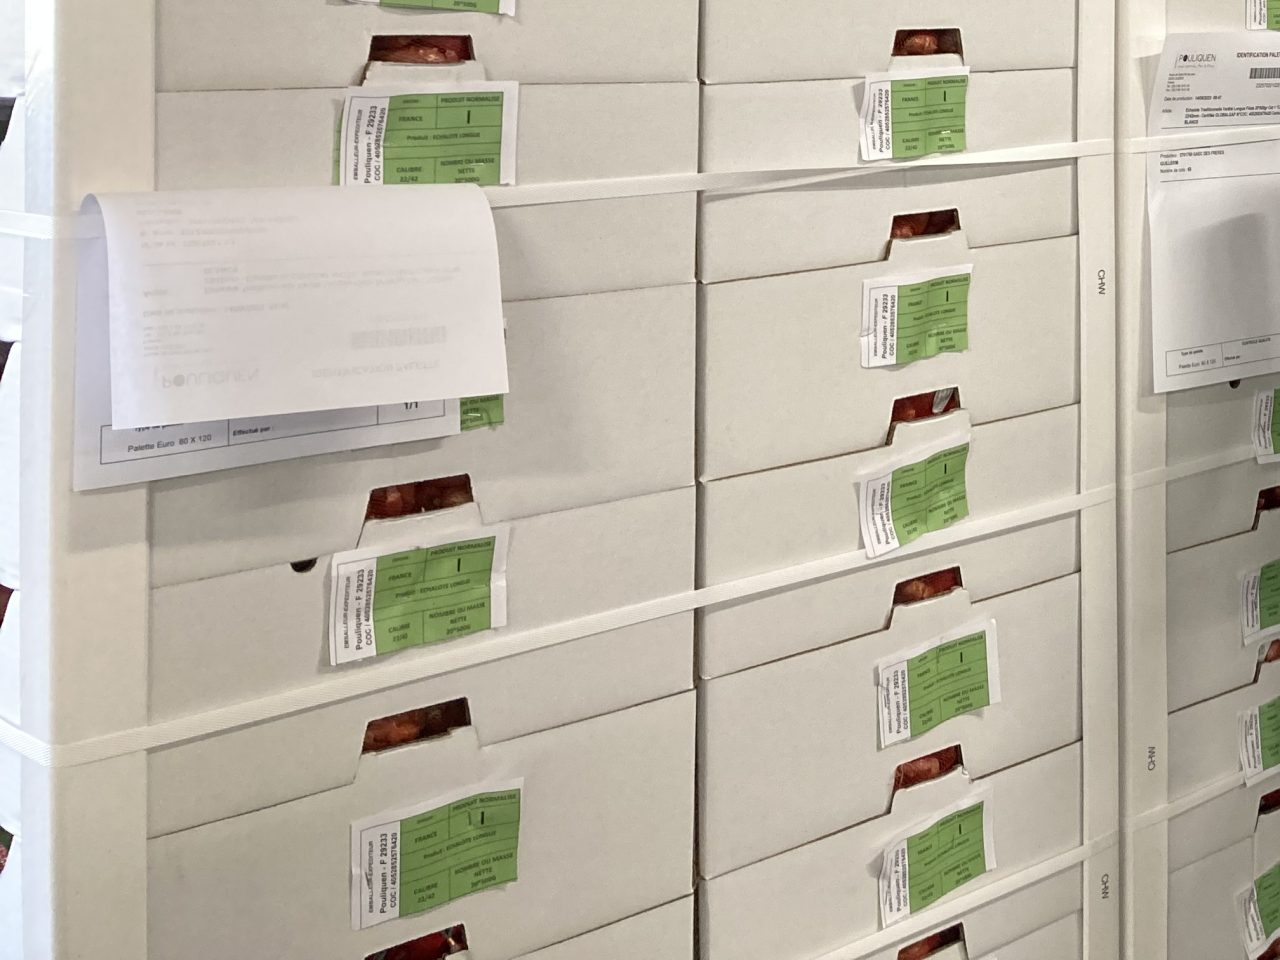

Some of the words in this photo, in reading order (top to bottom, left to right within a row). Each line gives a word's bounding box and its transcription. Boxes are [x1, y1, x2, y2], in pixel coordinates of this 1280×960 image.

[367, 105, 378, 128] 29233
[398, 114, 423, 122] FRANCE
[364, 142, 373, 184] Pouliquen
[1097, 269, 1106, 295] CHW
[127, 443, 155, 453] Palette
[157, 440, 175, 449] Euro
[190, 436, 196, 444] X
[198, 434, 212, 442] 120
[356, 569, 365, 593] 29233
[388, 572, 412, 582] FRANCE
[355, 607, 365, 650] Pouliquen
[364, 629, 372, 646] COC
[1147, 746, 1156, 771] CHW
[380, 833, 388, 857] 29233
[414, 831, 438, 844] FRANCE
[379, 872, 389, 914] Pouliquen
[1101, 873, 1109, 899] CHW
[389, 891, 398, 909] COC
